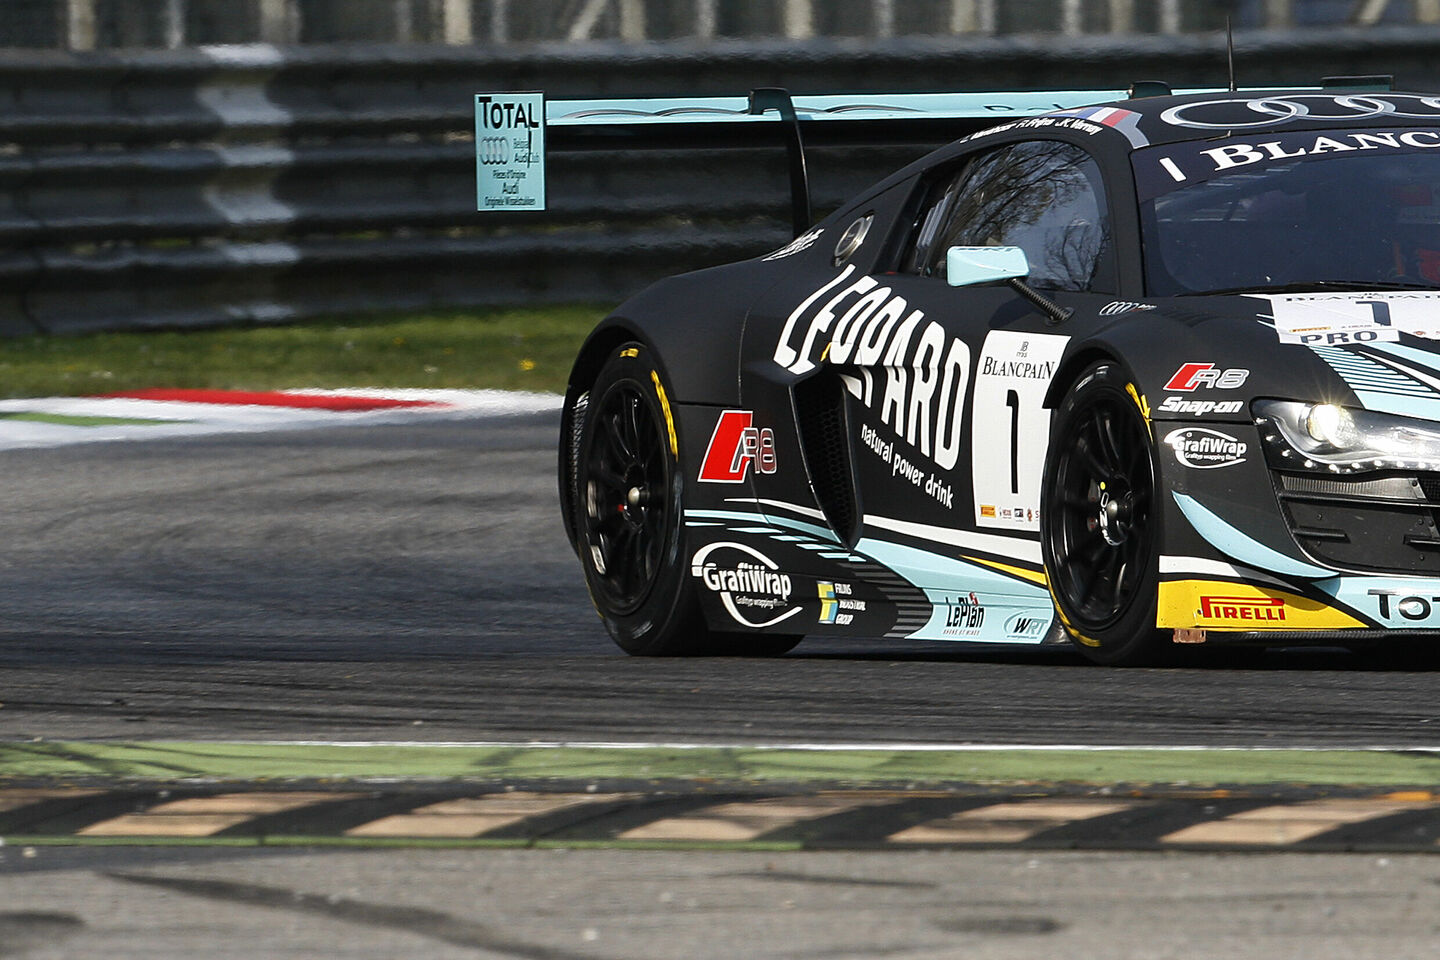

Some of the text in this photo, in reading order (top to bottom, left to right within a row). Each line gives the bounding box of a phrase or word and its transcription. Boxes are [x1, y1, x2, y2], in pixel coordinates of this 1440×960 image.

[478, 96, 540, 129] TOTAL
[1301, 331, 1378, 344] PRO
[773, 264, 971, 471] LEOPARD
[983, 356, 1055, 380] BLANCPAIN
[1158, 397, 1244, 416] Snap-on
[1006, 389, 1019, 494] 1
[1173, 436, 1247, 457] GrafiWrap
[861, 424, 953, 509] natural power drink
[703, 563, 792, 600] GrafiWrap
[1200, 596, 1286, 620] PIRELLI
[1013, 617, 1049, 635] WRT
